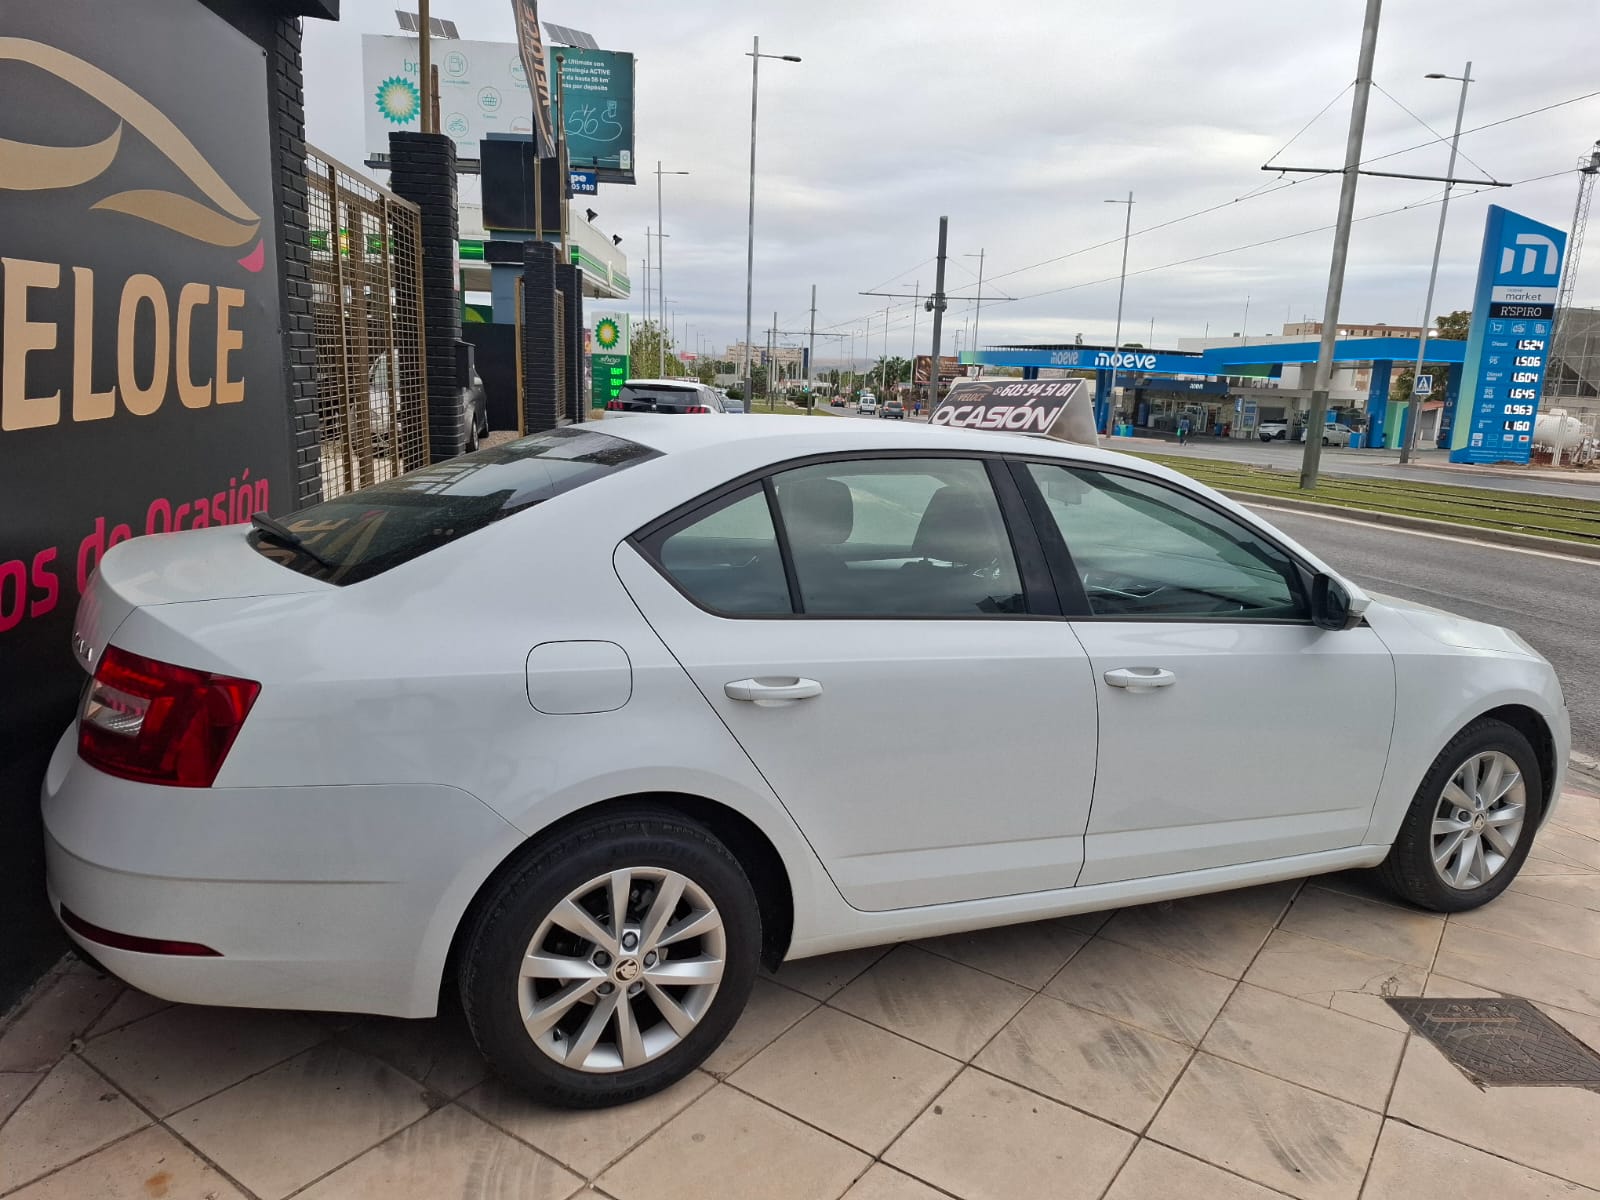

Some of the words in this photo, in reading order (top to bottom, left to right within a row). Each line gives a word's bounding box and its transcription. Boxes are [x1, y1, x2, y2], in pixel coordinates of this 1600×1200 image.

[1505, 292, 1542, 301] market
[1050, 351, 1079, 365] moeve
[1094, 352, 1157, 369] moeve
[1000, 383, 1029, 397] 603
[1022, 383, 1046, 397] 94
[1055, 383, 1076, 397] 81
[932, 399, 1060, 430] OCASIÓN
